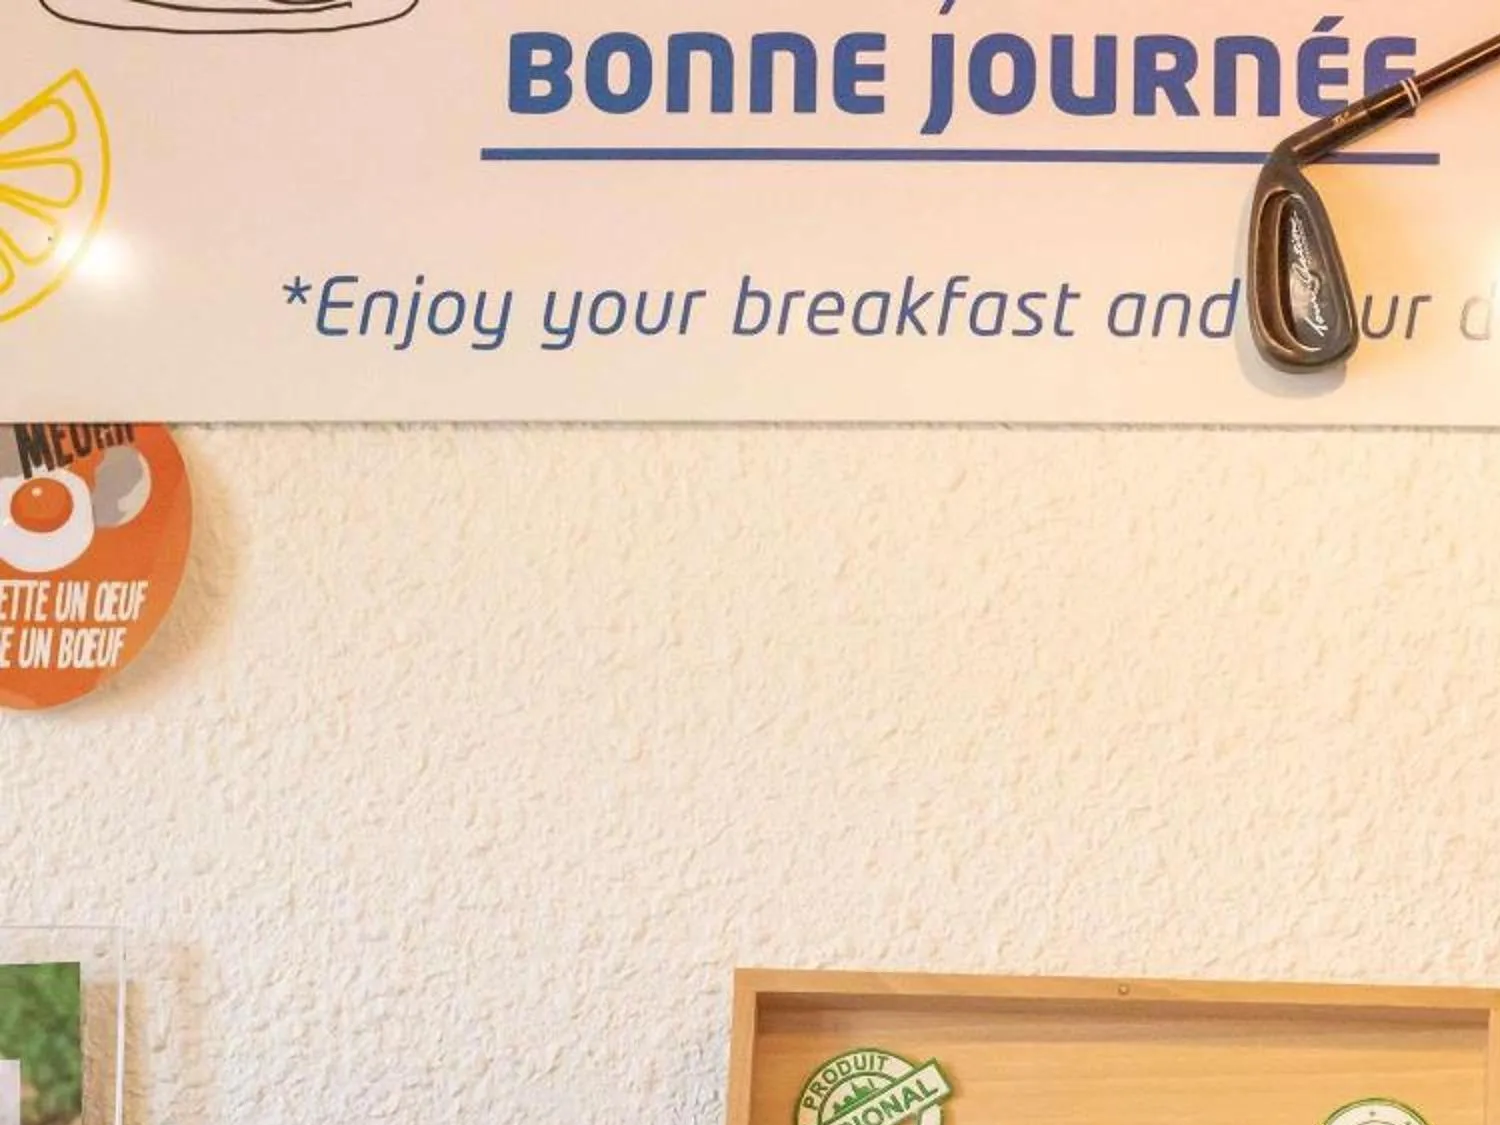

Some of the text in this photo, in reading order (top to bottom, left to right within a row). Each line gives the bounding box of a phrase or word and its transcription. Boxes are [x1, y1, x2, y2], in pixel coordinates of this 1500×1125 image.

[508, 31, 887, 115] BONNE
[540, 289, 707, 350] your
[732, 275, 1082, 337] breakfast
[1107, 278, 1242, 338] and
[1361, 294, 1432, 339] ur
[0, 579, 149, 622] ETTE UN ŒUF
[18, 627, 54, 669] UN
[57, 627, 127, 670] BŒUF
[802, 1055, 889, 1112] PRODUIT
